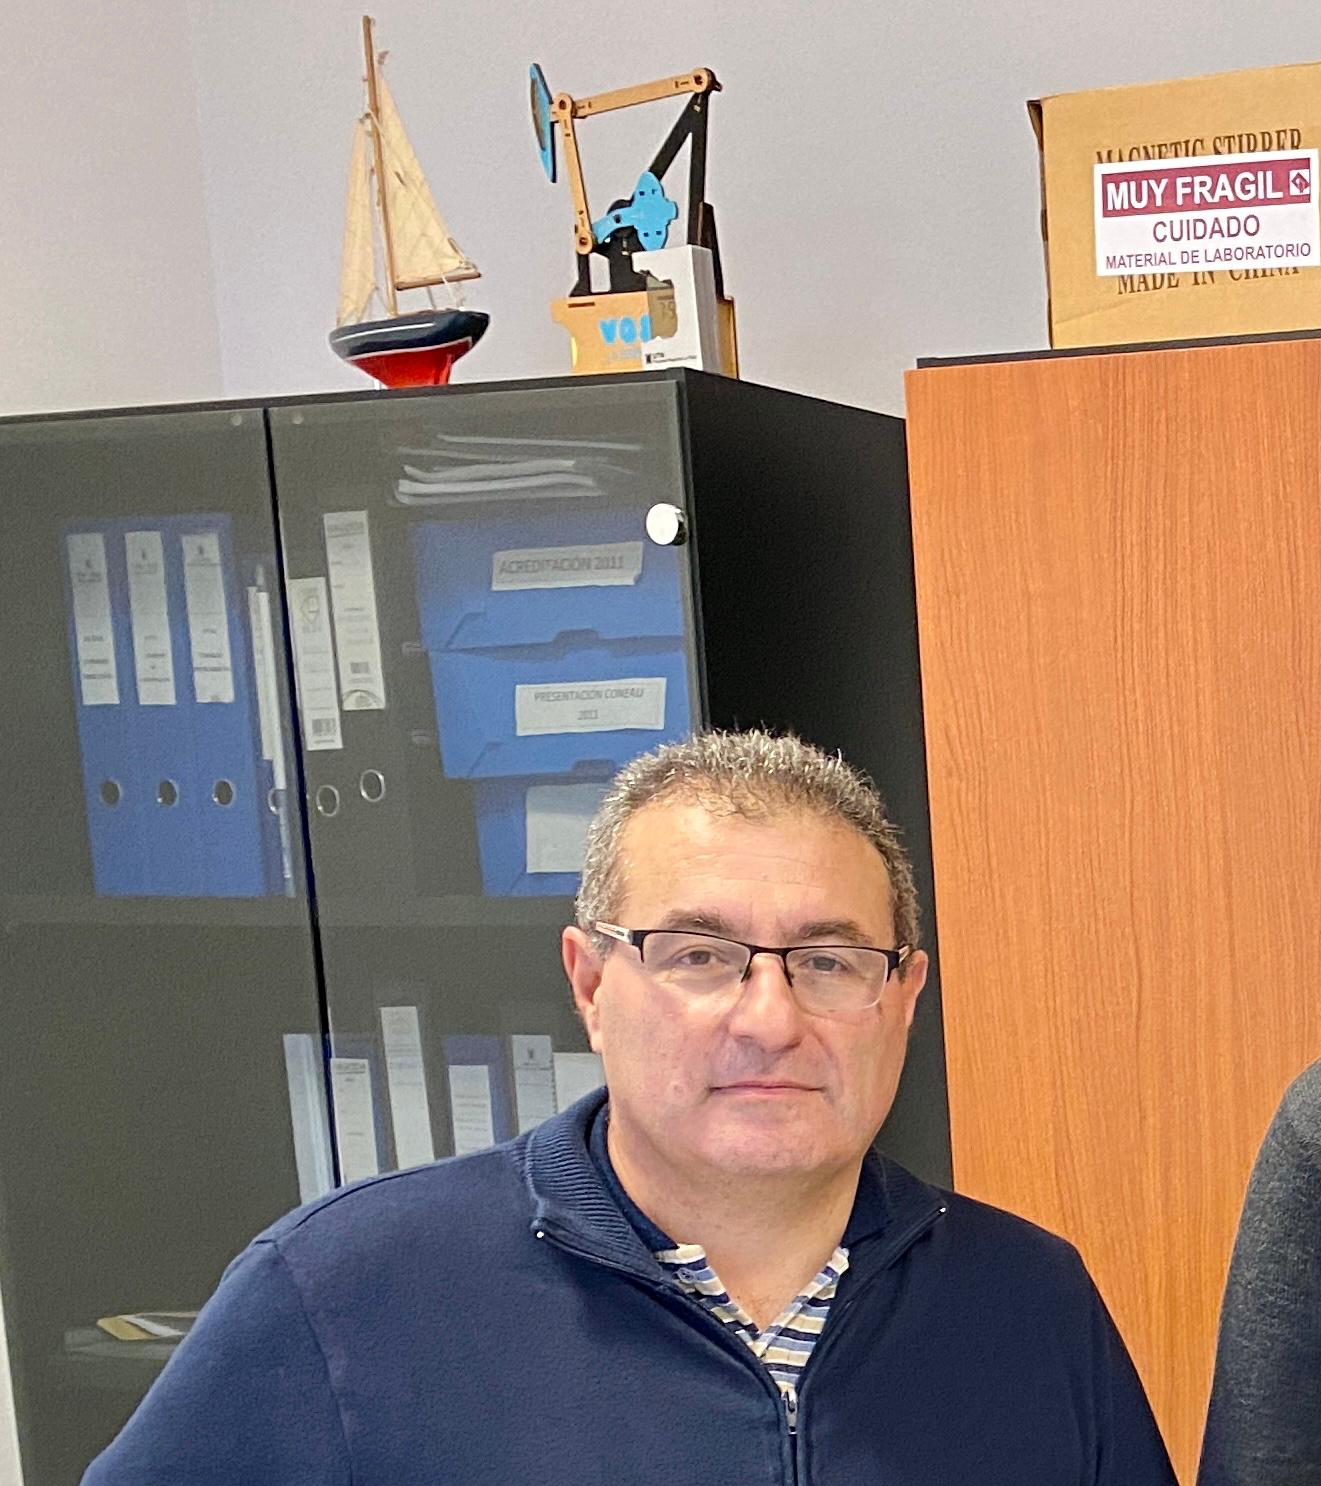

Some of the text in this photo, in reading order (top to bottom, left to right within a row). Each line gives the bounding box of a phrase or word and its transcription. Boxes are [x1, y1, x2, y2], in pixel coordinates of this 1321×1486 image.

[1106, 170, 1283, 211] MUY FRAGIL
[1153, 214, 1260, 243] CUIDADO
[1106, 243, 1311, 269] MATERIAL DE LABORATORIO
